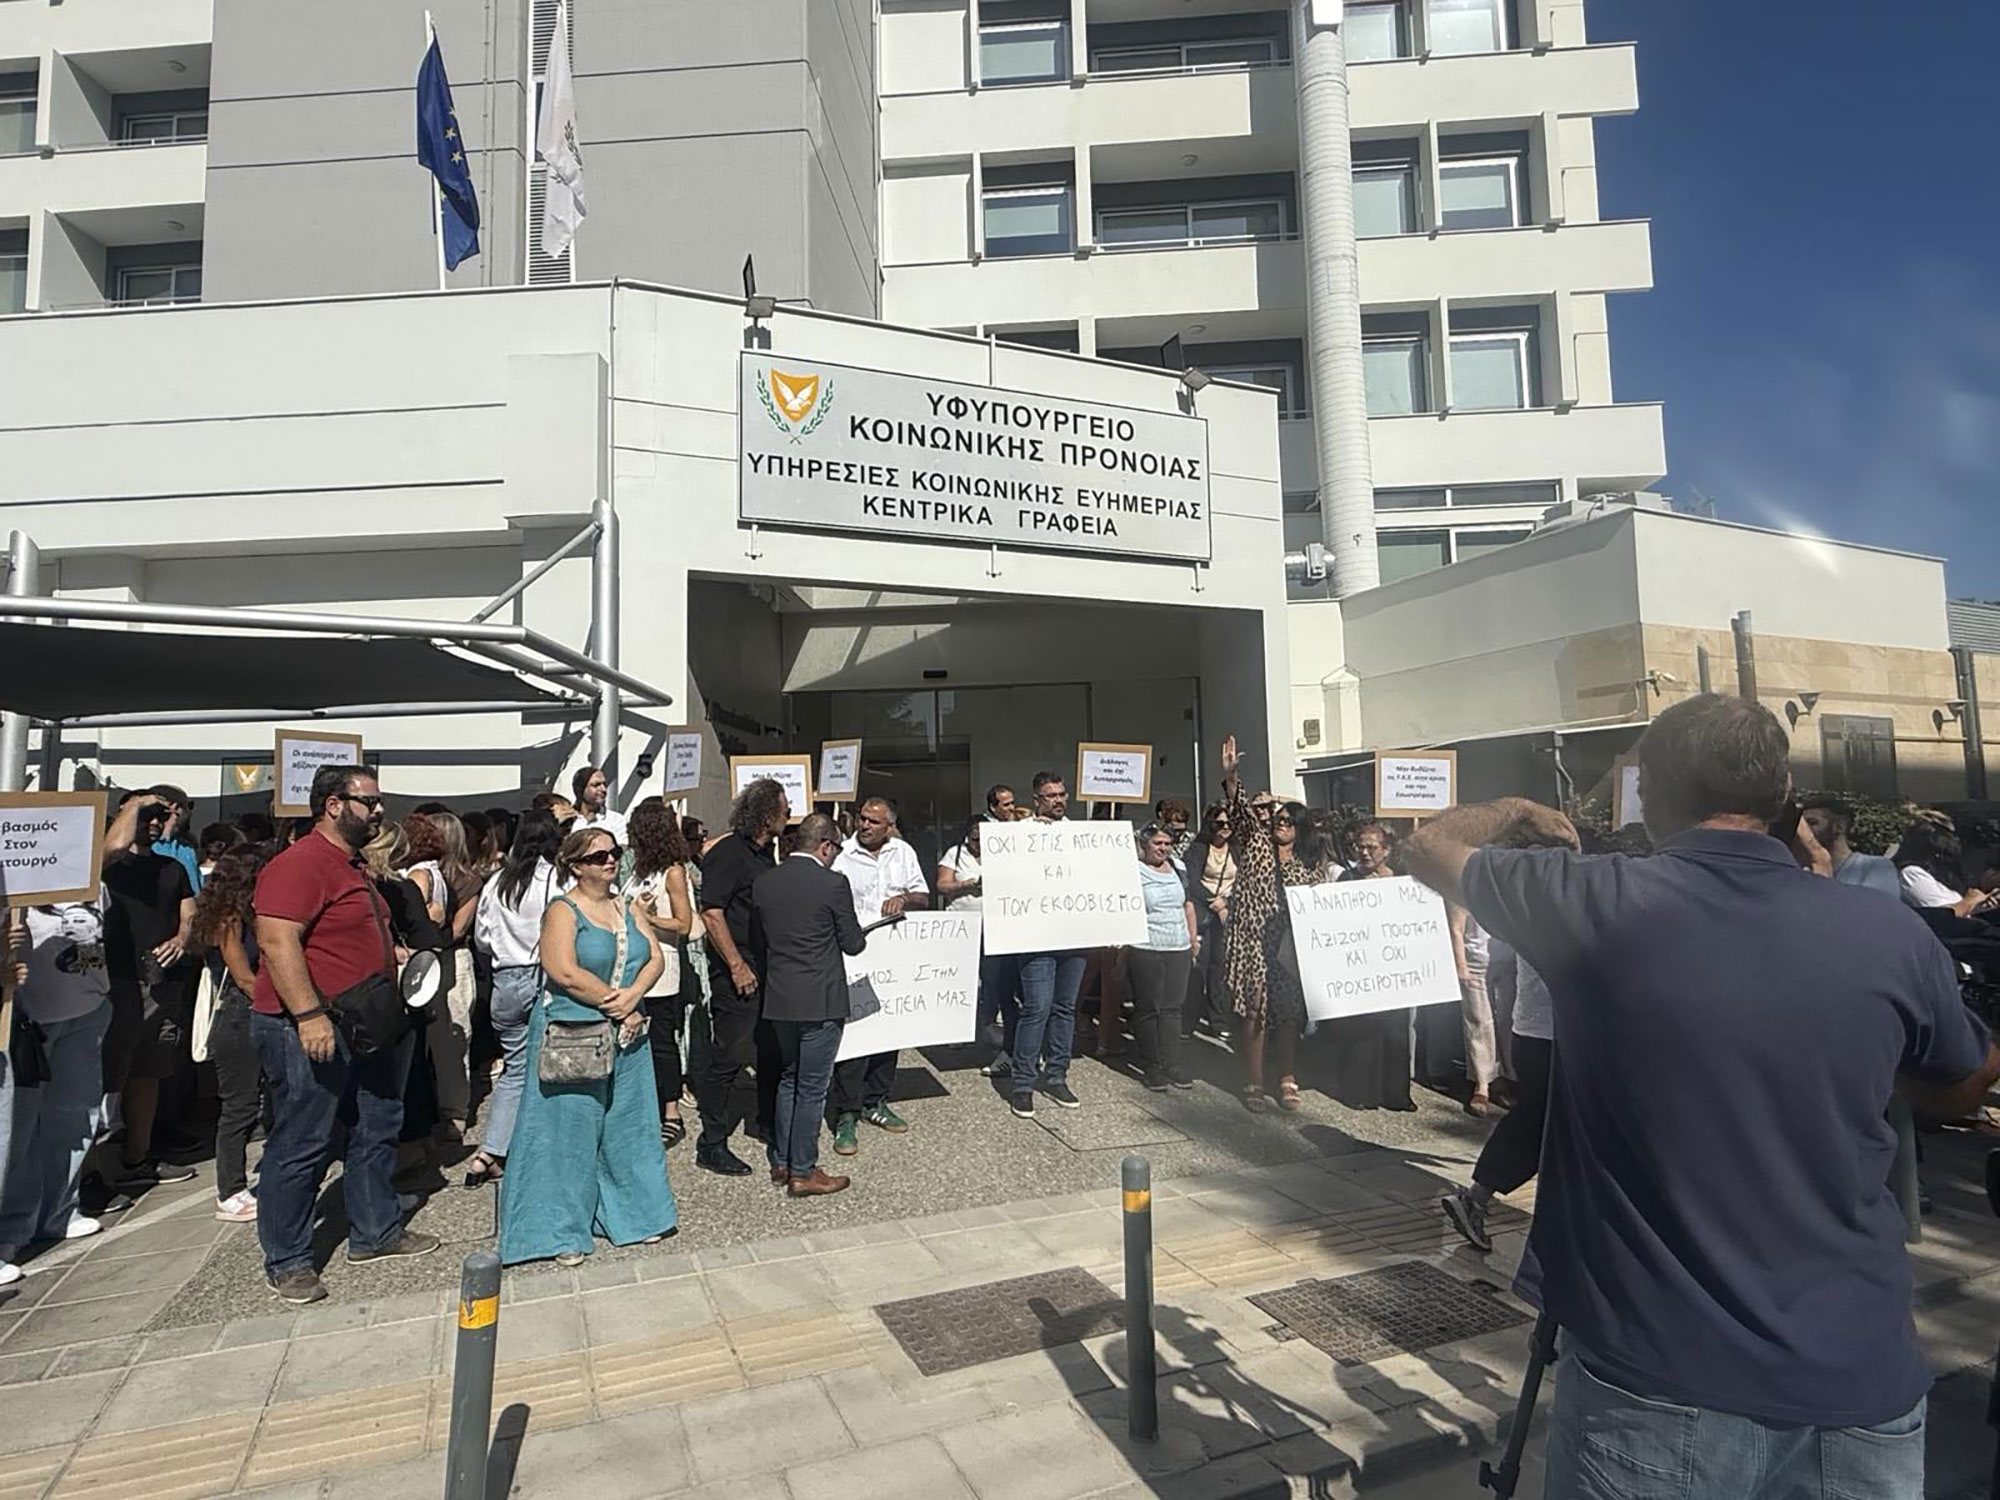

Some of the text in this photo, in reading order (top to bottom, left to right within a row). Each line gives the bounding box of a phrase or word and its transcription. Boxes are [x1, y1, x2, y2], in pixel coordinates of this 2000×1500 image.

[926, 392, 1135, 442] ΥΦΥΠΟΥΡΓΕΙΟ
[850, 415, 1201, 481] ΚΟΙΝΩΝΙΚΗΣ ΠΡΟΝΟΙΑΣ
[747, 452, 1202, 520] ΥΠΗΡΕΣΙΕΣ ΚΟΙΝΩΝΙΚΗΣ ΕΥΗΜΕΡΙΑΣ
[863, 495, 1119, 537] ΚΕΝΤΡΙΚΑ ΓΡΑΦΕΙΑ
[0, 819, 58, 836] βασμός
[4, 839, 38, 851] Στον
[987, 833, 1132, 855] ΟΧΙ ΣΤΙΣ ΑΠΕΙΛΕΣ
[0, 853, 58, 869] ιτουργό
[1043, 864, 1072, 881] ΚΑΙ
[998, 893, 1142, 917] ΤΟΝ ΕΚΦΟΒΙΣΜΟ
[1312, 888, 1383, 911] ΑΝΑΠΗΡΟΙ
[1399, 884, 1429, 904] ΜΑΣ
[1311, 925, 1370, 950] ΑΞΙΖΟΥΝ
[1346, 944, 1407, 967] ΚΑΙ ΟΧΙ
[914, 963, 959, 982] ΣΤΗΝ
[937, 989, 971, 1007] ΜΑΣ
